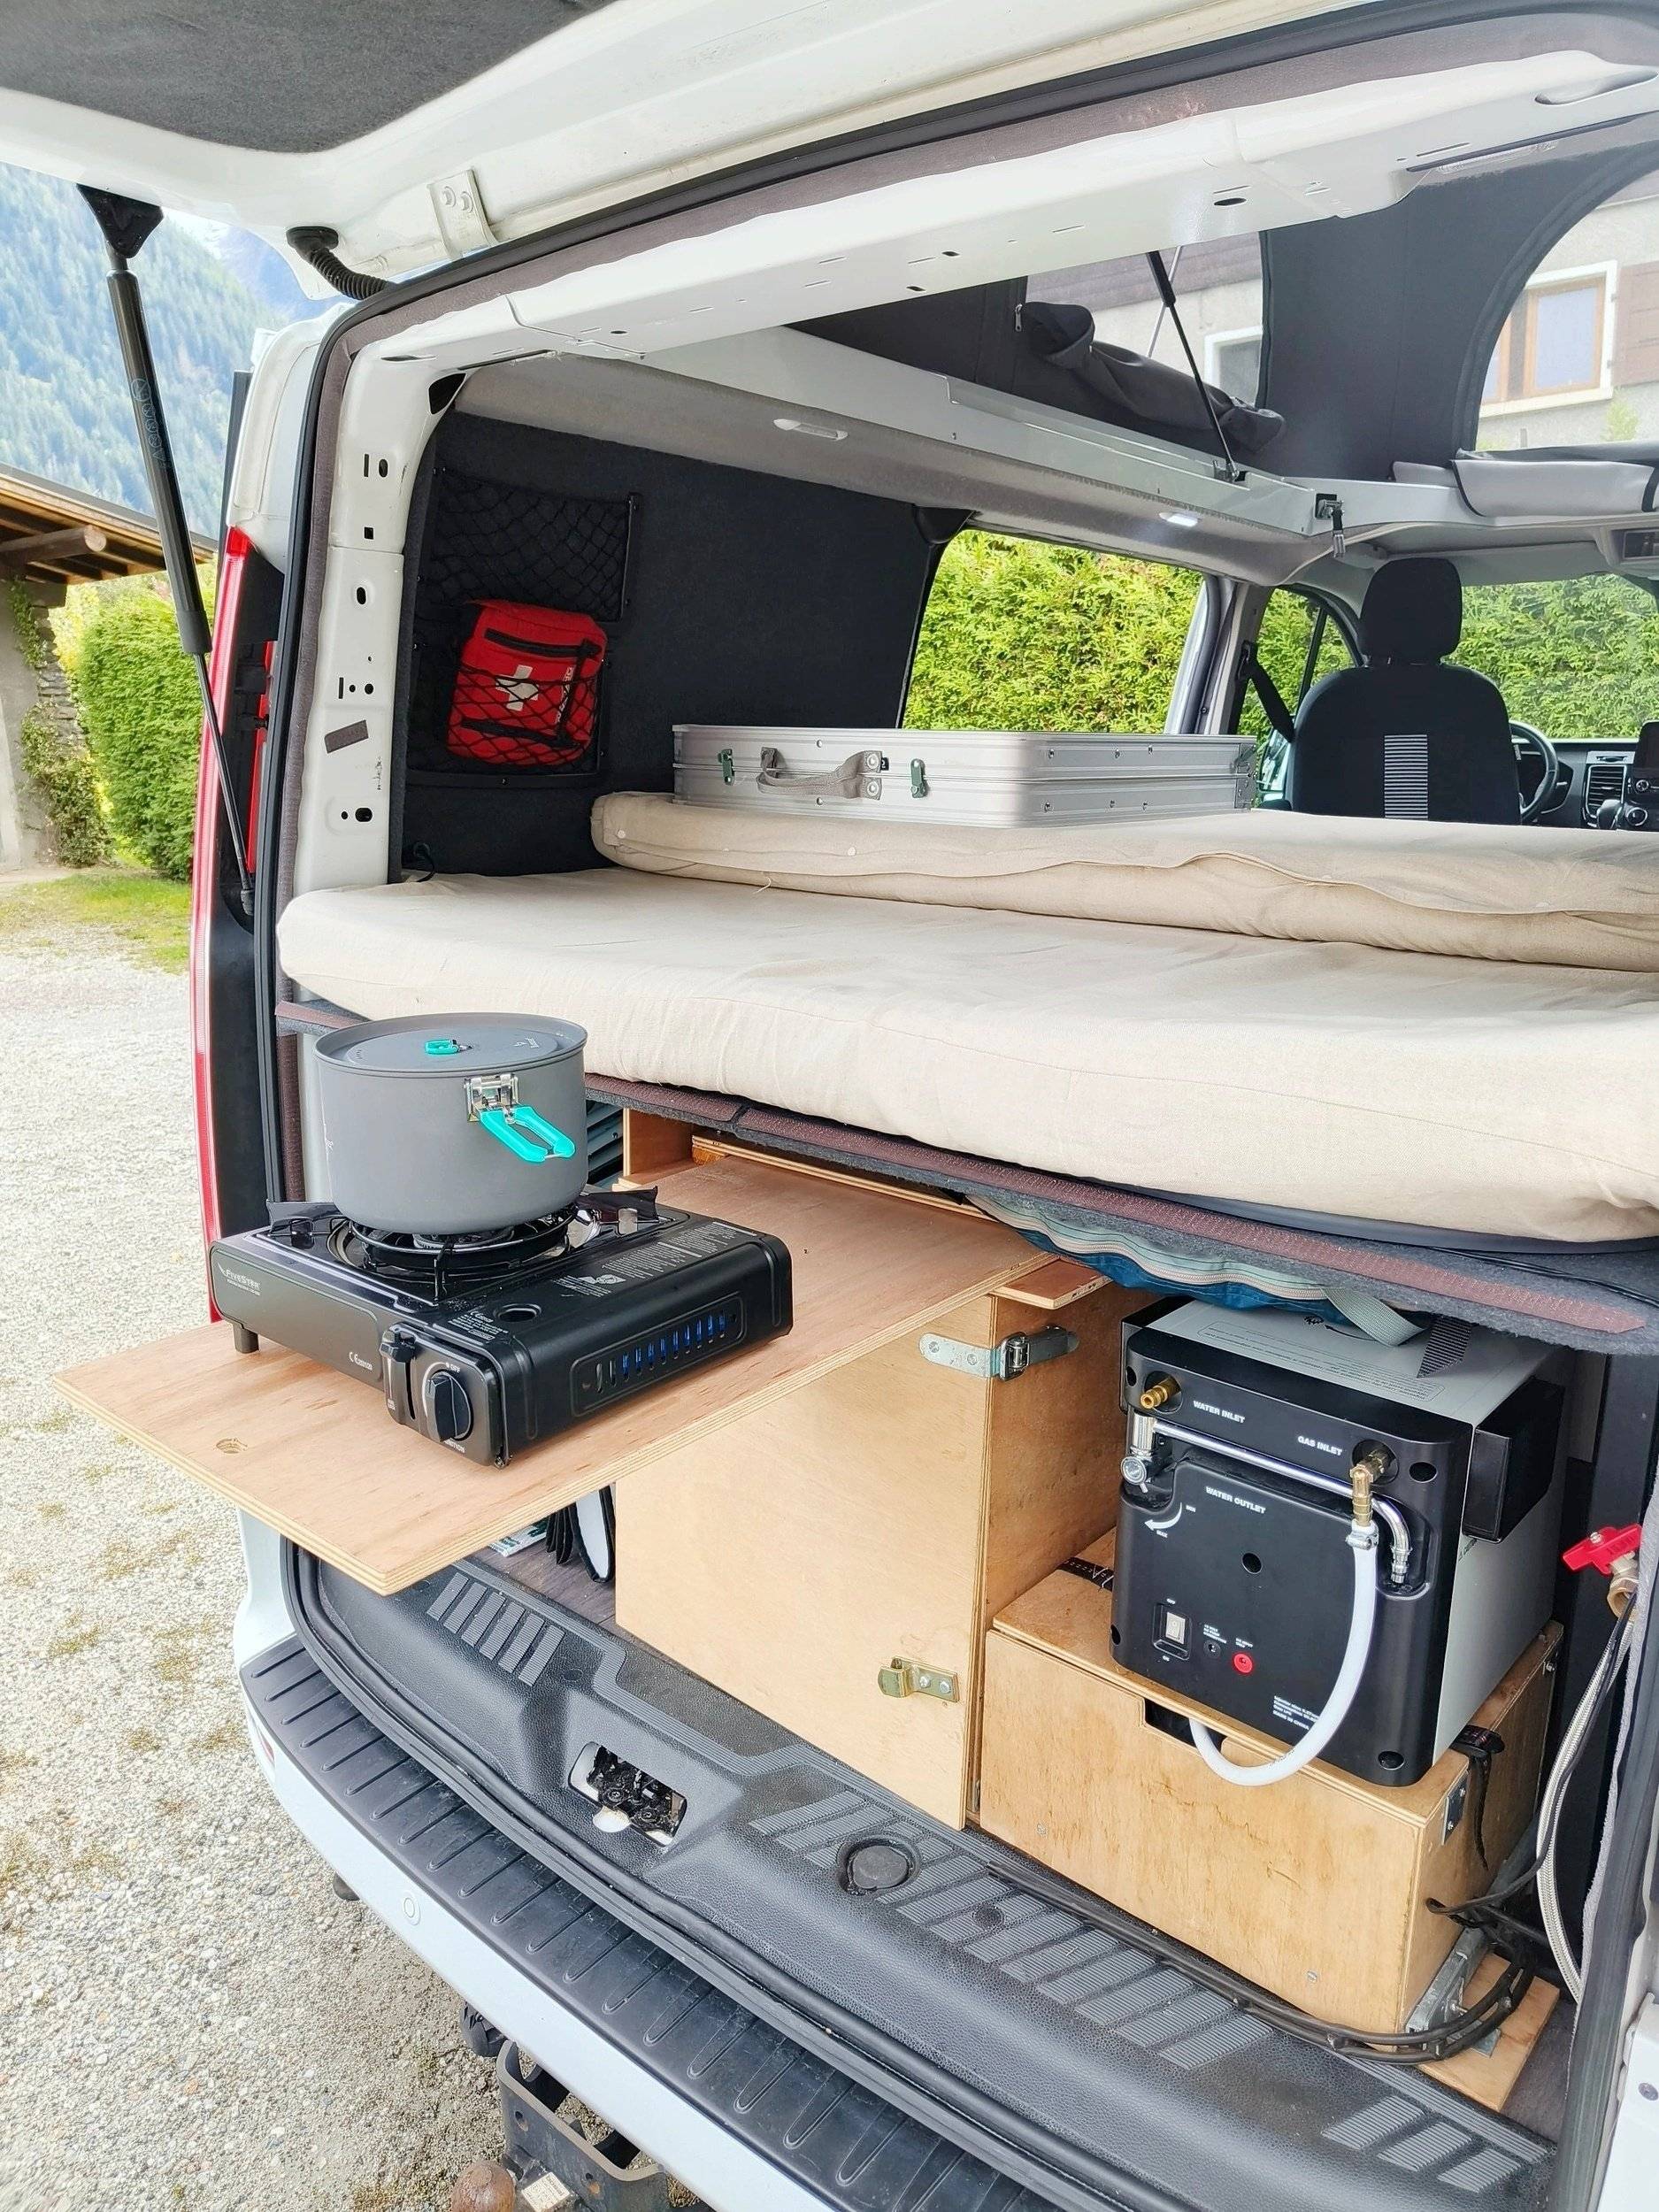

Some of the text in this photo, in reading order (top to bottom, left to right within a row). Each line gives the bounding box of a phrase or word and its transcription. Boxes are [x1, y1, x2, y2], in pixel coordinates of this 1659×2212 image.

[1193, 1400, 1246, 1424] WATER INLET
[1297, 1435, 1343, 1456] GAS INLET
[1205, 1486, 1266, 1514] WATER OUTLET
